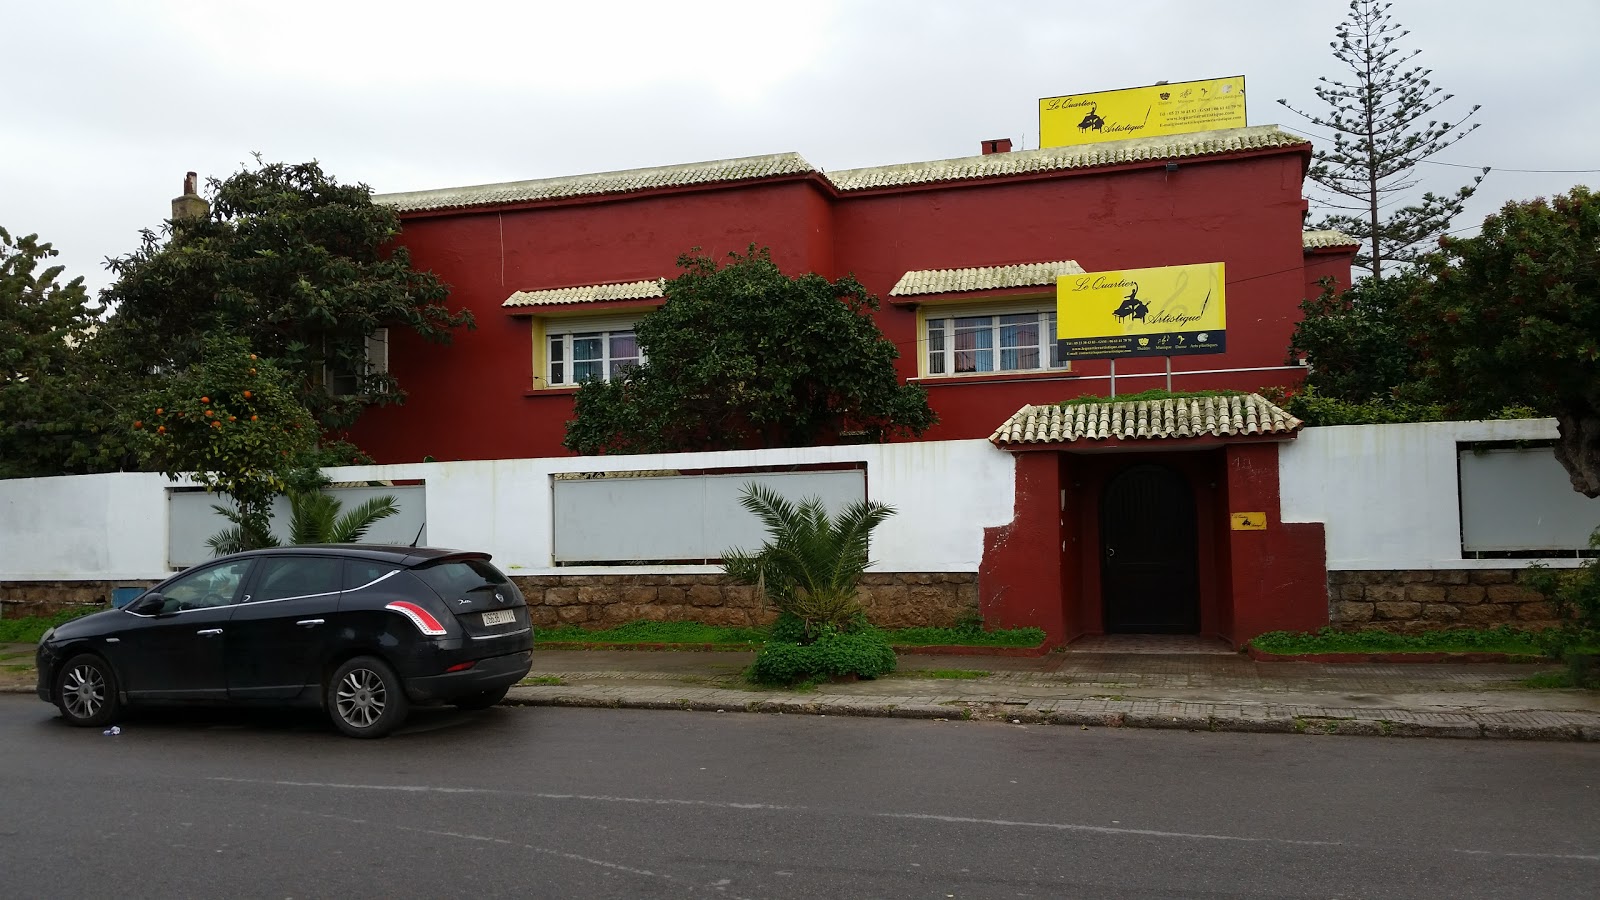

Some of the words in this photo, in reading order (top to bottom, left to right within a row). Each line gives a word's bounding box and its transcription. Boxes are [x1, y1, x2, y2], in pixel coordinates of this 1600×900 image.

[1046, 99, 1060, 111] Le
[1061, 98, 1097, 110] Quartier
[1072, 277, 1089, 292] Le
[1092, 276, 1138, 291] Quartier
[1145, 309, 1201, 327] Artistique
